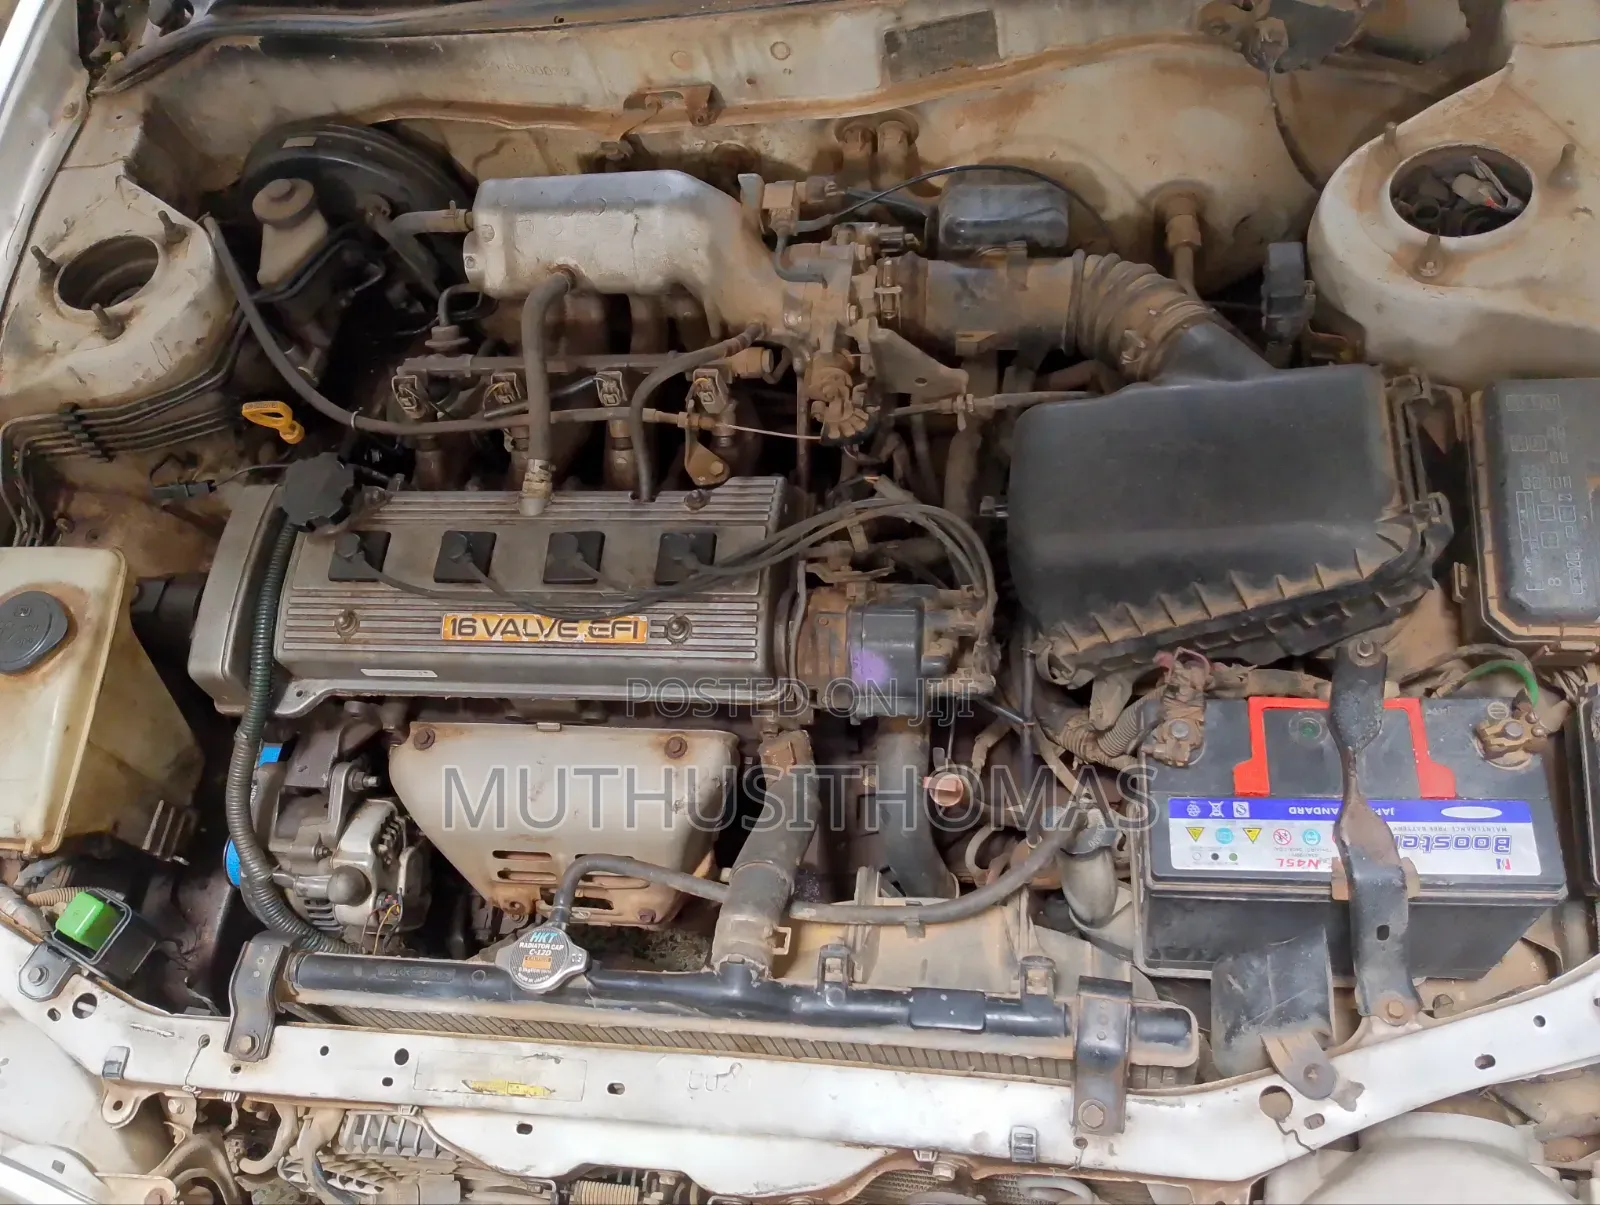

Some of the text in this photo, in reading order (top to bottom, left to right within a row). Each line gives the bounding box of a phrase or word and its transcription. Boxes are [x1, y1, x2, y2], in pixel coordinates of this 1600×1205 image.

[451, 617, 639, 639] 16 VALVE EFI
[530, 931, 558, 943] HKT
[519, 942, 551, 950] RADIATOR
